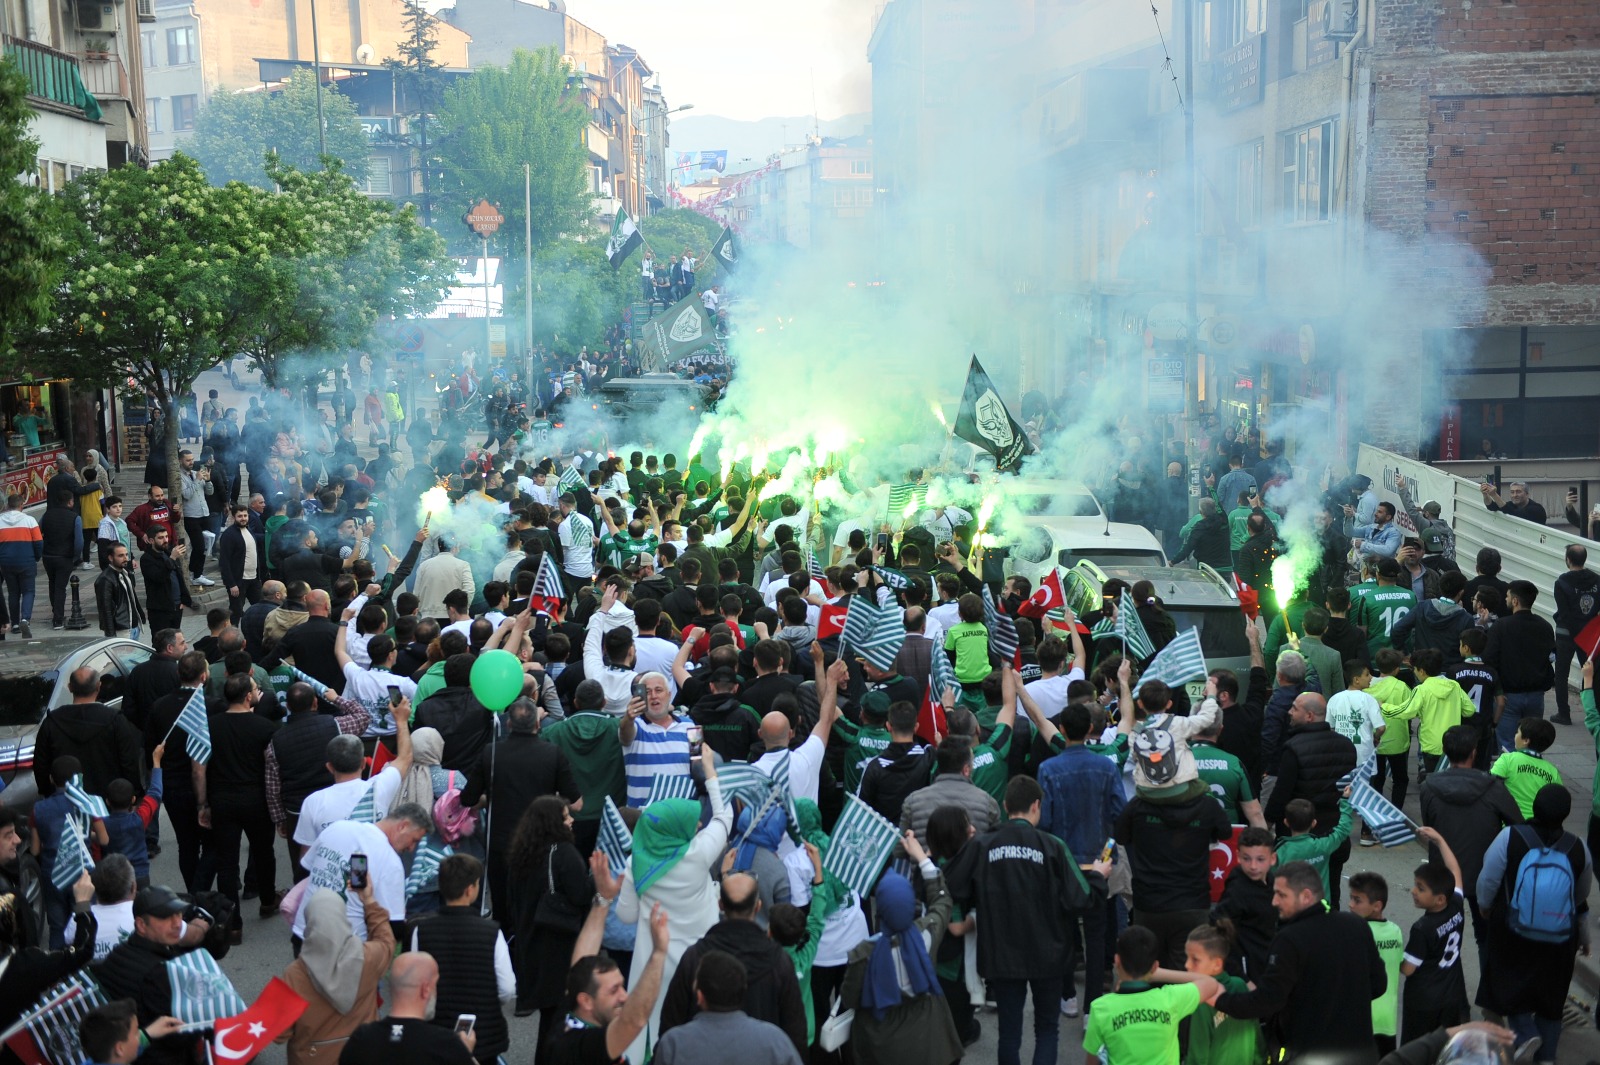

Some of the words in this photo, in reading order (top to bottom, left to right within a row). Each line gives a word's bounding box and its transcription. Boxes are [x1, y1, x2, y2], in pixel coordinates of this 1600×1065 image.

[1446, 423, 1454, 461] PIRLA
[1374, 592, 1411, 601] KAFKASSPOR
[962, 630, 988, 638] KAFKASSPO
[270, 674, 289, 684] ASSPOR
[1456, 669, 1479, 680] KAFKAS
[1467, 684, 1483, 712] 4
[972, 752, 995, 769] SSPOR
[1195, 759, 1228, 770] KASSPOR
[1517, 764, 1553, 784] KAFKASSPOR
[988, 845, 1044, 865] KAFKASSPOR
[1111, 1008, 1172, 1032] KAFKASSPOR
